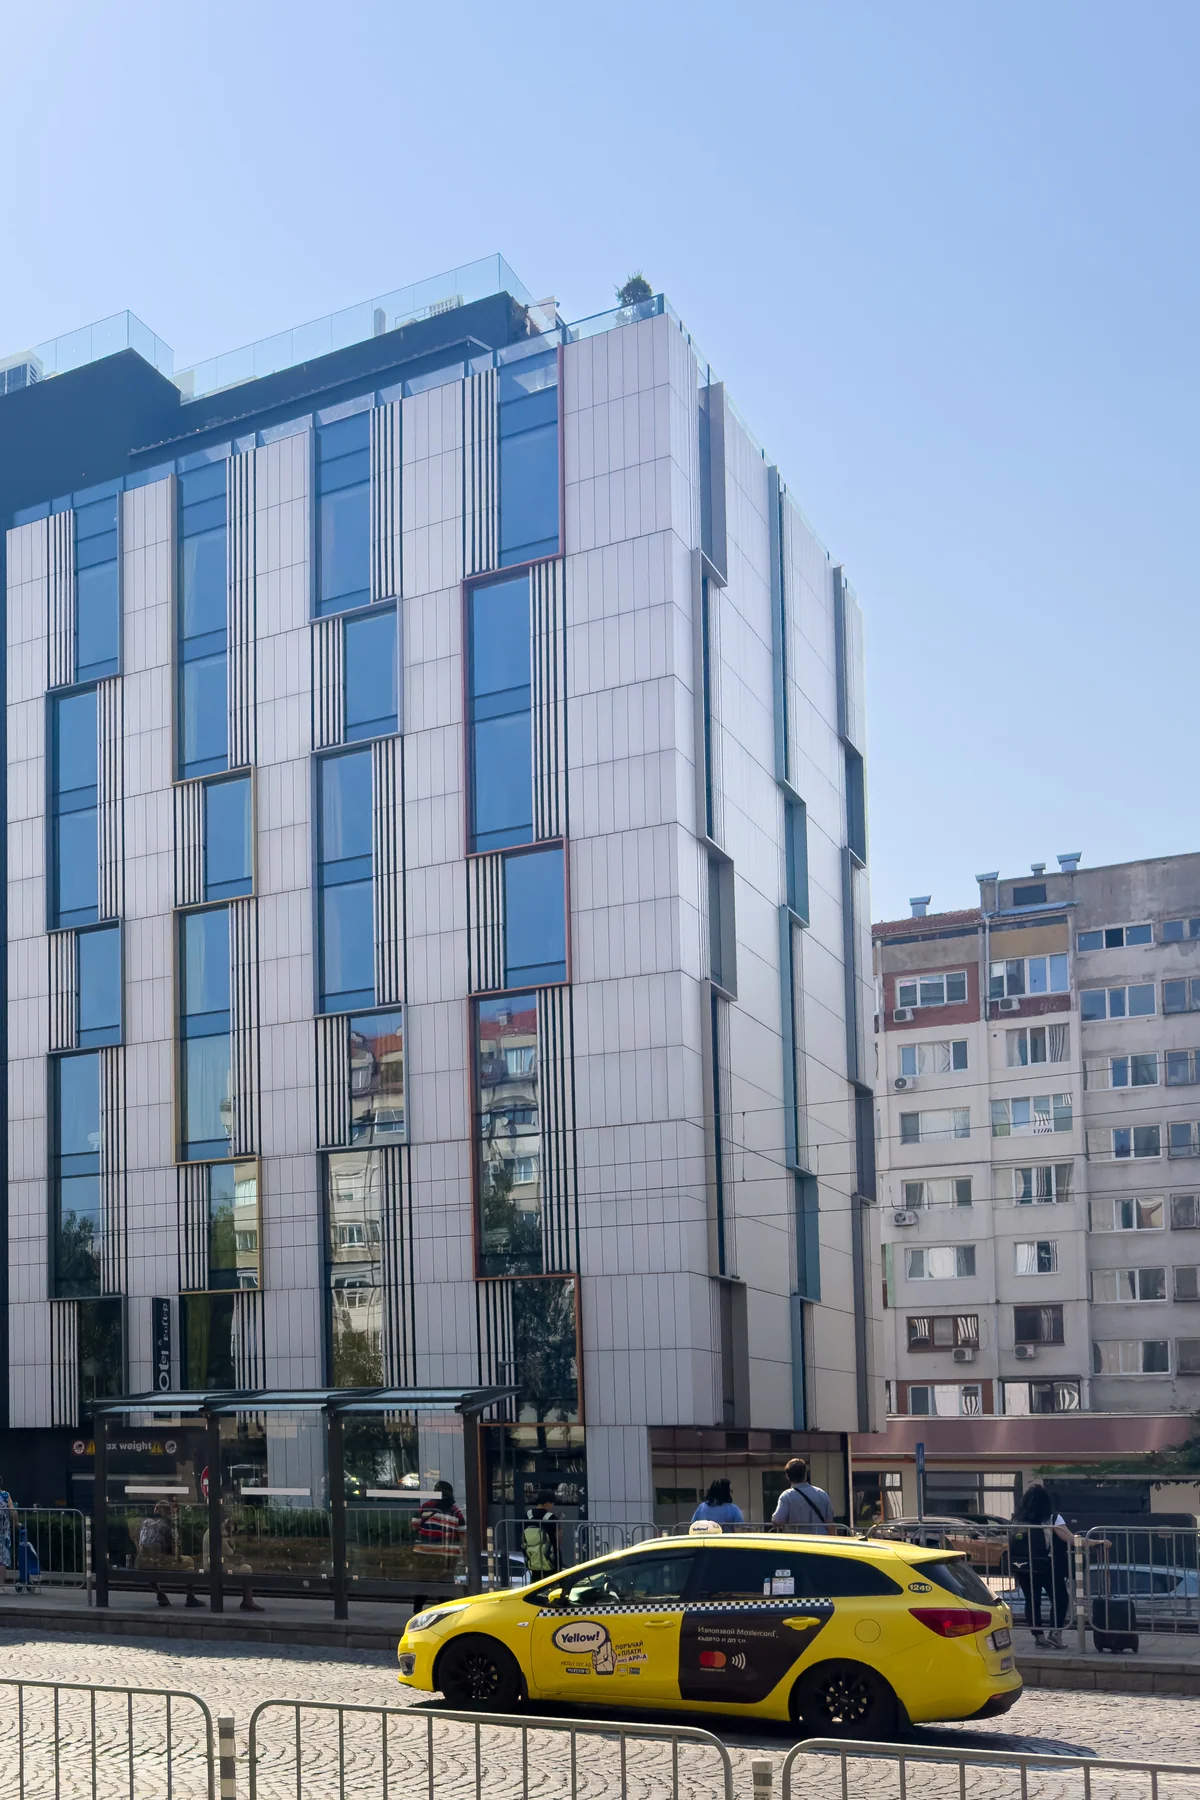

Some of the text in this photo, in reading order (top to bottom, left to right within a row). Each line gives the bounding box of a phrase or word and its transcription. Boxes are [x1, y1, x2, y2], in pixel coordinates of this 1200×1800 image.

[159, 1350, 170, 1392] otel
[119, 1441, 152, 1452] weight
[910, 1584, 932, 1592] 1249
[698, 1626, 735, 1635] Използвай
[561, 1631, 600, 1644] Yellow!
[615, 1640, 644, 1651] ПОРЪЧАЙ
